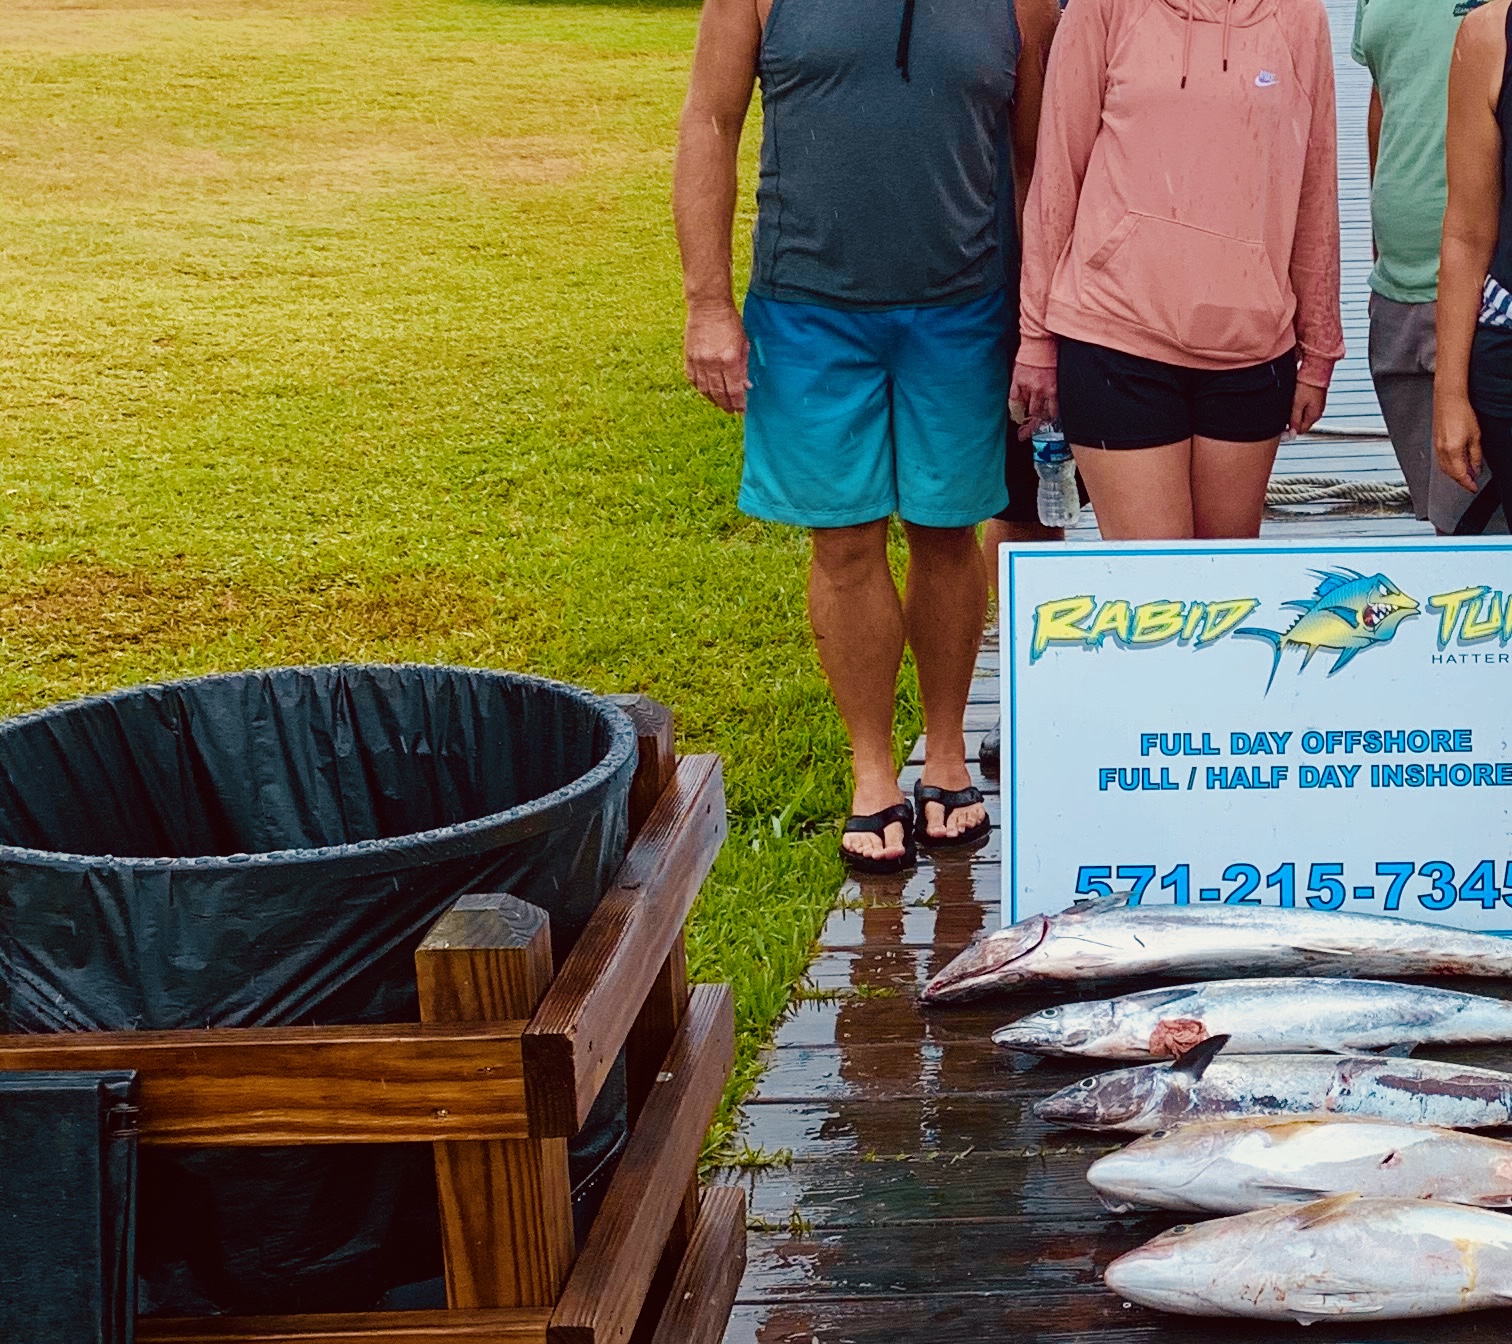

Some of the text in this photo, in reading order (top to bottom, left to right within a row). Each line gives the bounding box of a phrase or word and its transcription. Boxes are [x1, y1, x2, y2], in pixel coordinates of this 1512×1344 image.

[1032, 595, 1261, 660] RABID
[1140, 729, 1473, 756] FULL DAY OFFSHORE
[1099, 767, 1179, 791] FULL
[1187, 766, 1197, 790] /
[1206, 766, 1289, 789] HALF
[1298, 764, 1362, 788] DAY
